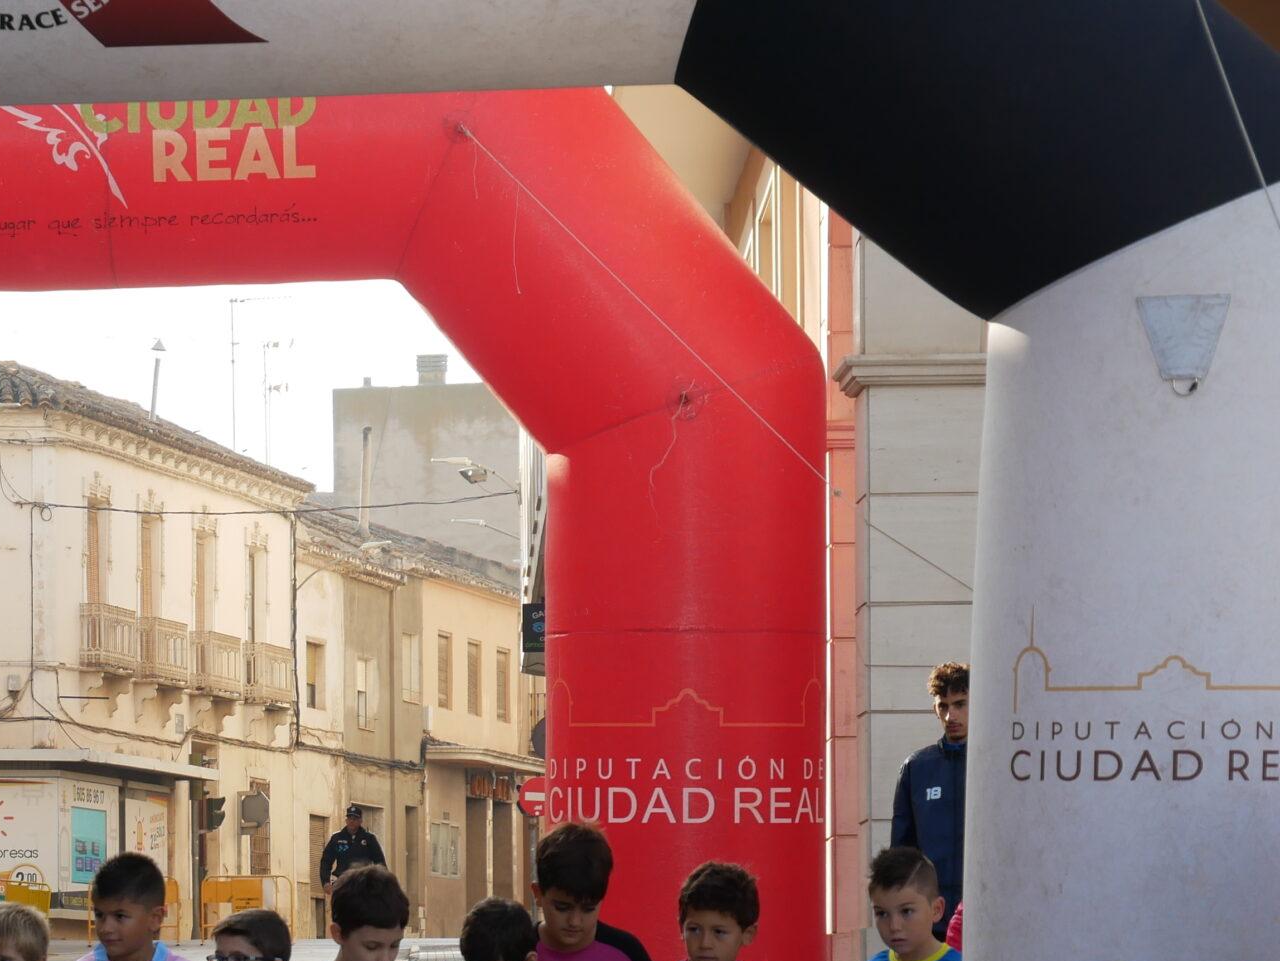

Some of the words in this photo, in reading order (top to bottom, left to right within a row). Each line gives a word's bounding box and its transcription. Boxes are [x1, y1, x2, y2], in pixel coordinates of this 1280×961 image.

[0, 8, 68, 31] RACE
[80, 97, 317, 133] CIUDAD
[152, 125, 317, 182] REAL
[48, 216, 82, 237] que
[94, 212, 179, 230] siempre
[1012, 718, 1274, 741] DIPUTACIÓN
[549, 756, 785, 780] DIPUTACIÓN
[803, 757, 824, 780] DE
[1010, 750, 1204, 781] CIUDAD
[549, 787, 716, 824] CIUDAD
[733, 786, 825, 824] REAL
[926, 785, 942, 801] 18
